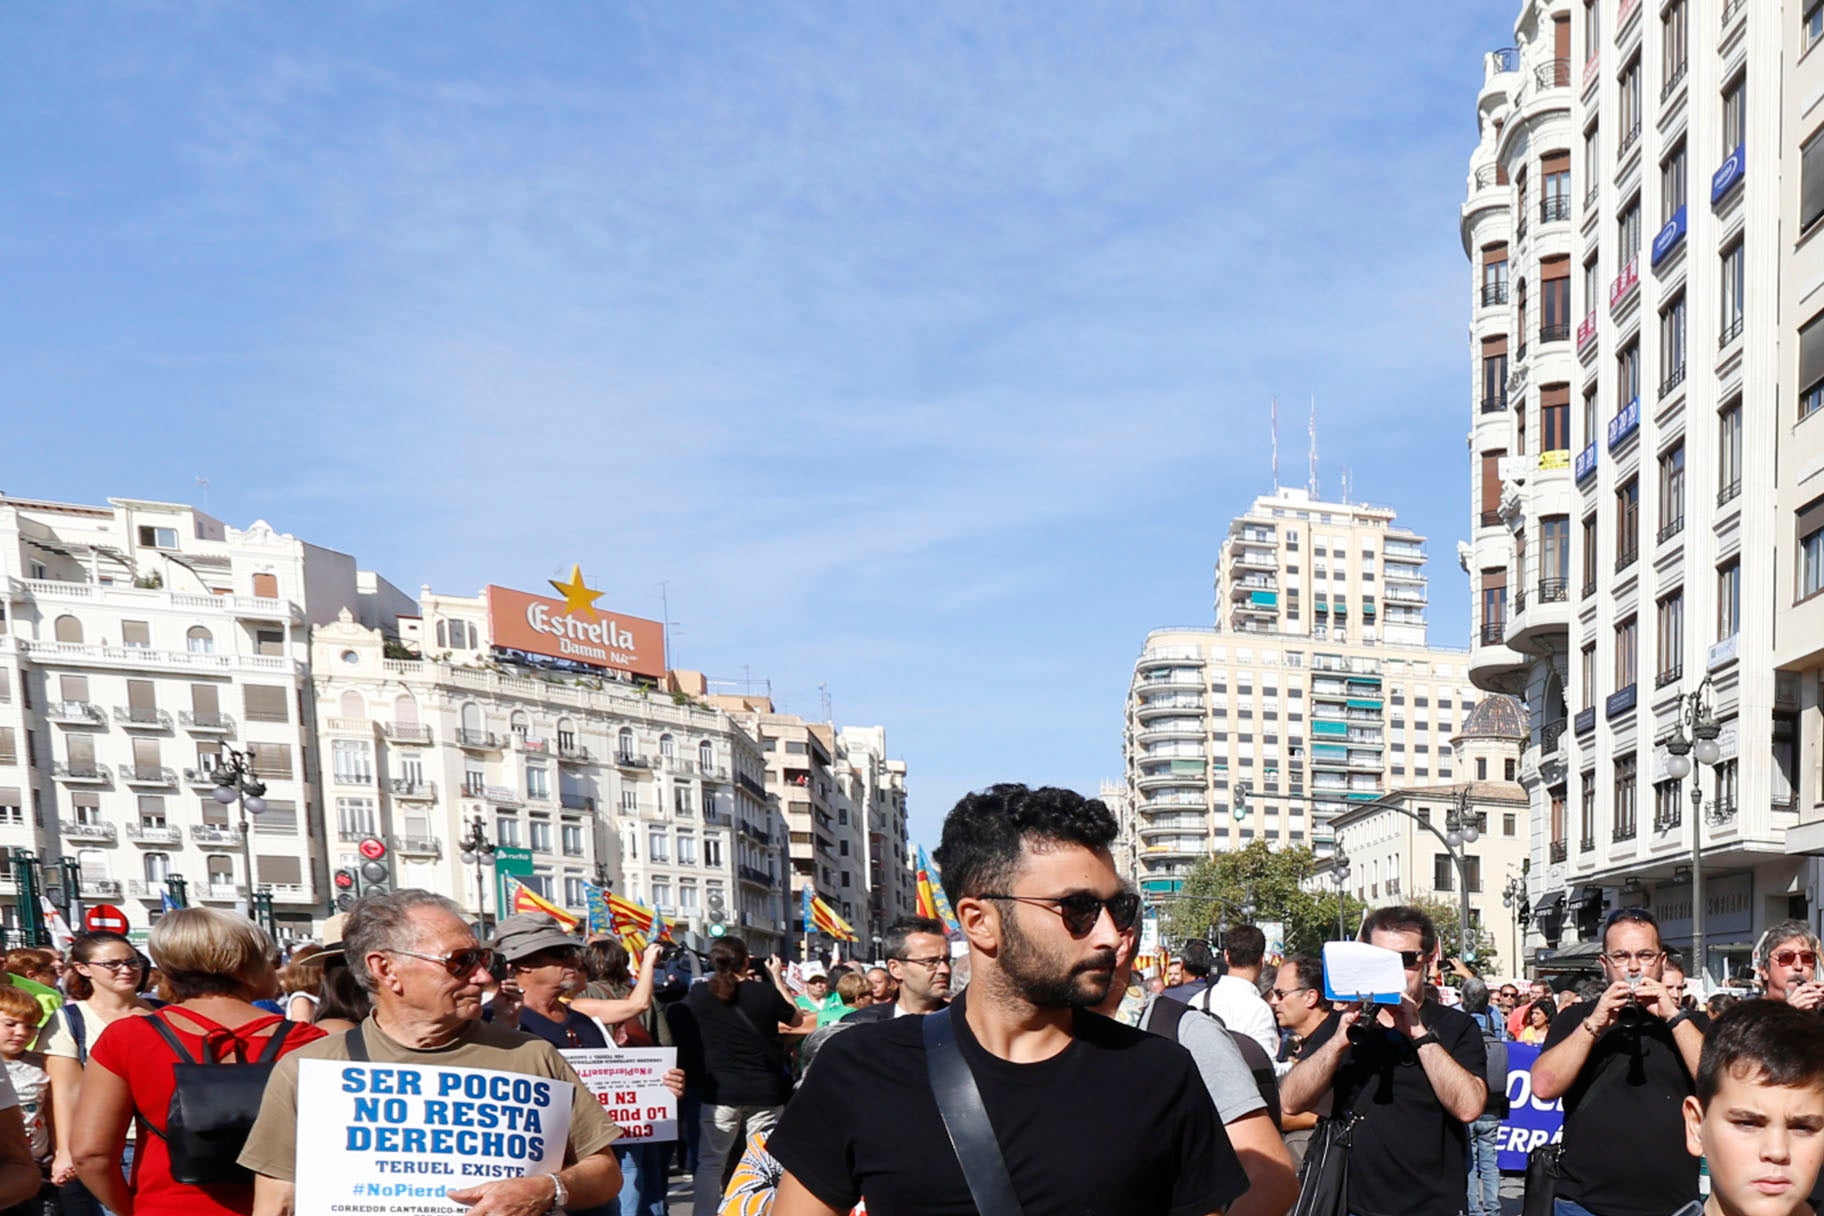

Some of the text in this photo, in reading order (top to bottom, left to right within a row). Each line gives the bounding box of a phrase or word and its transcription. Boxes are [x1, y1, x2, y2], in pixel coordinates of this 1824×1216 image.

[526, 601, 635, 651] Estrella
[560, 638, 606, 660] Damm
[342, 1067, 550, 1107] SER POCOS
[615, 1091, 637, 1104] EN
[354, 1097, 542, 1134] NO RESTA
[647, 1107, 667, 1120] LO
[346, 1126, 544, 1162] DERECHOS
[376, 1160, 525, 1178] TERUEL EXISTE
[331, 1204, 387, 1213] CORREDOR
